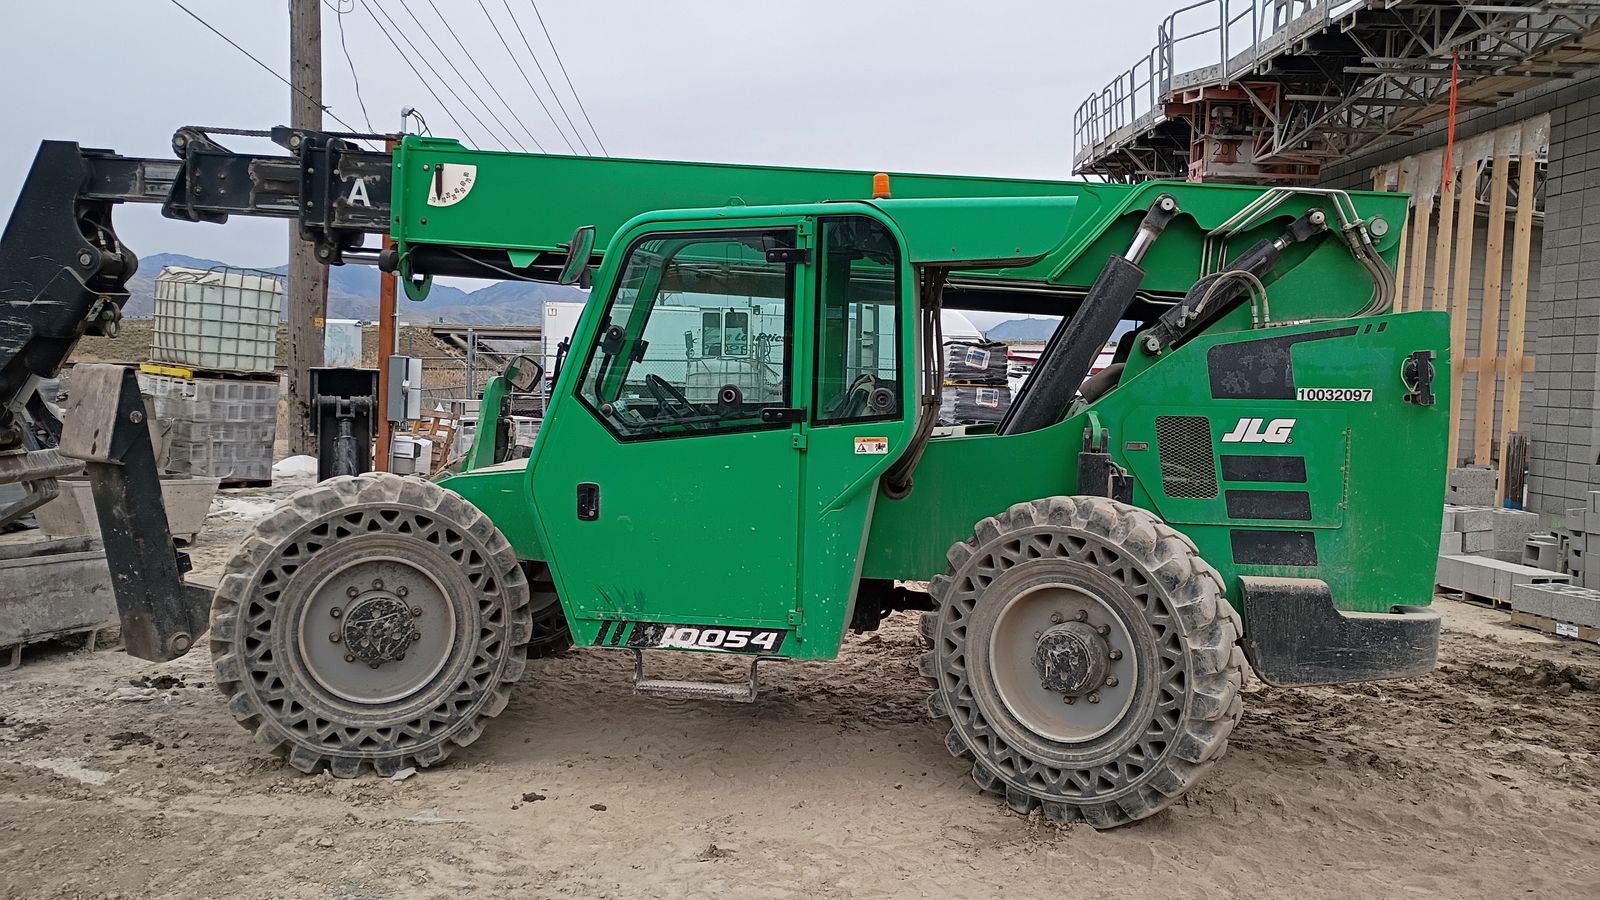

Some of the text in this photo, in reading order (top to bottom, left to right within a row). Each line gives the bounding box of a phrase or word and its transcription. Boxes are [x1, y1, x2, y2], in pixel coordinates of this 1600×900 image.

[1213, 142, 1229, 155] 20
[347, 178, 370, 206] A
[1299, 389, 1371, 401] 10032097
[1221, 418, 1297, 443] JLG
[660, 627, 778, 650] 10054
